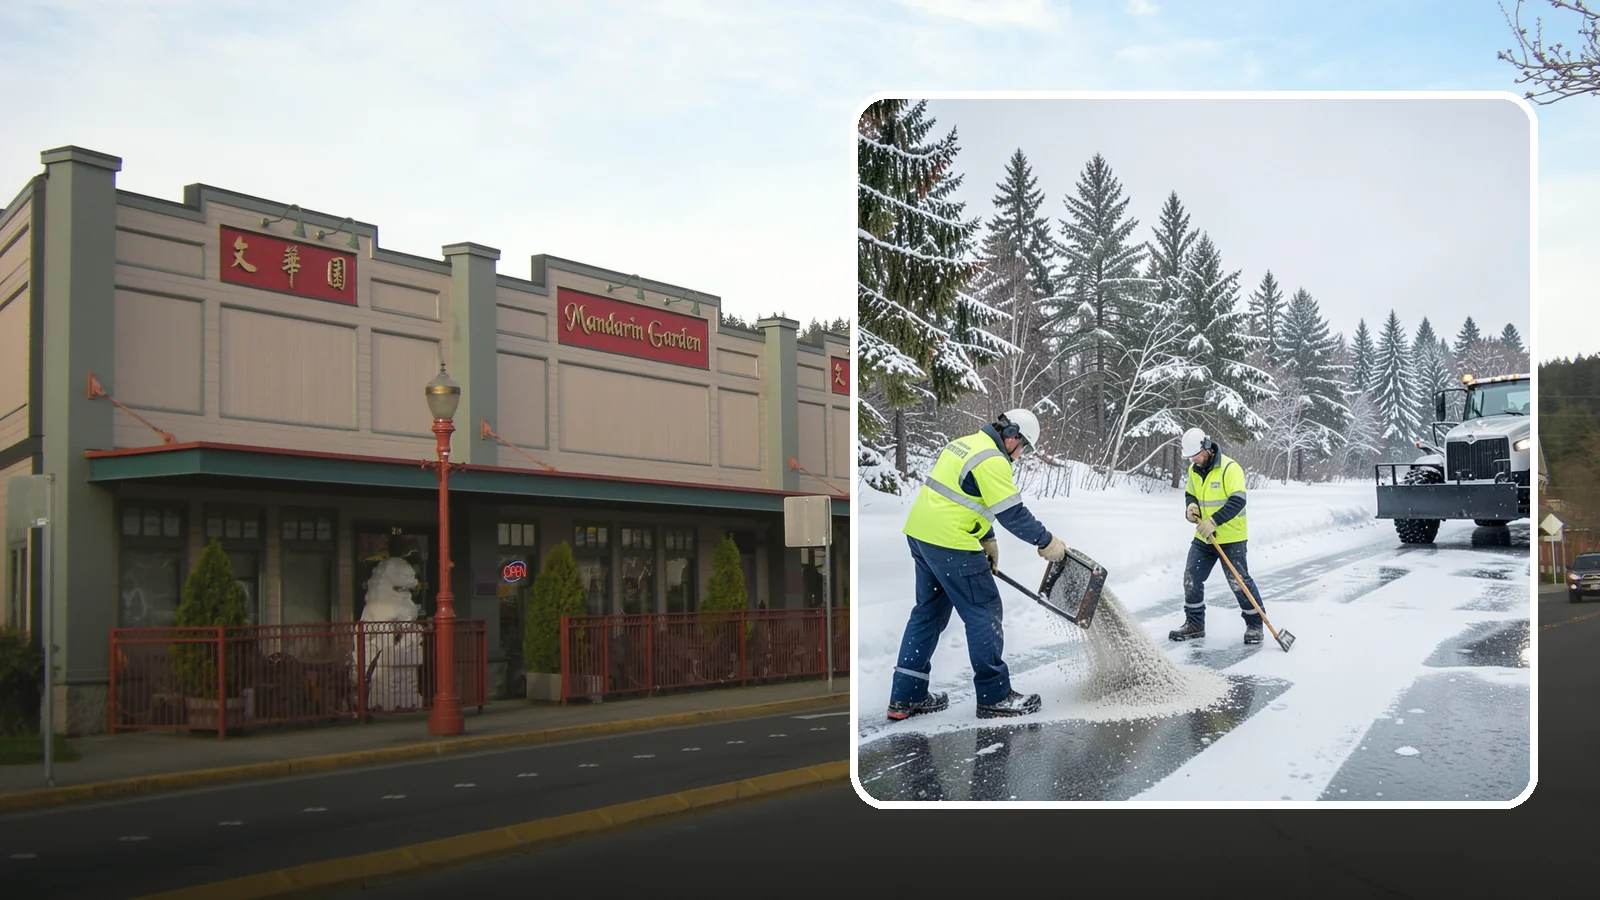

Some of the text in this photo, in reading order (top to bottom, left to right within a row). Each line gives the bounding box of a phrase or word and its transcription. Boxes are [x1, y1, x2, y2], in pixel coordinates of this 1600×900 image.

[231, 236, 346, 291] 文華園
[564, 302, 701, 352] Mandarin Garden
[503, 565, 527, 578] OPEN
